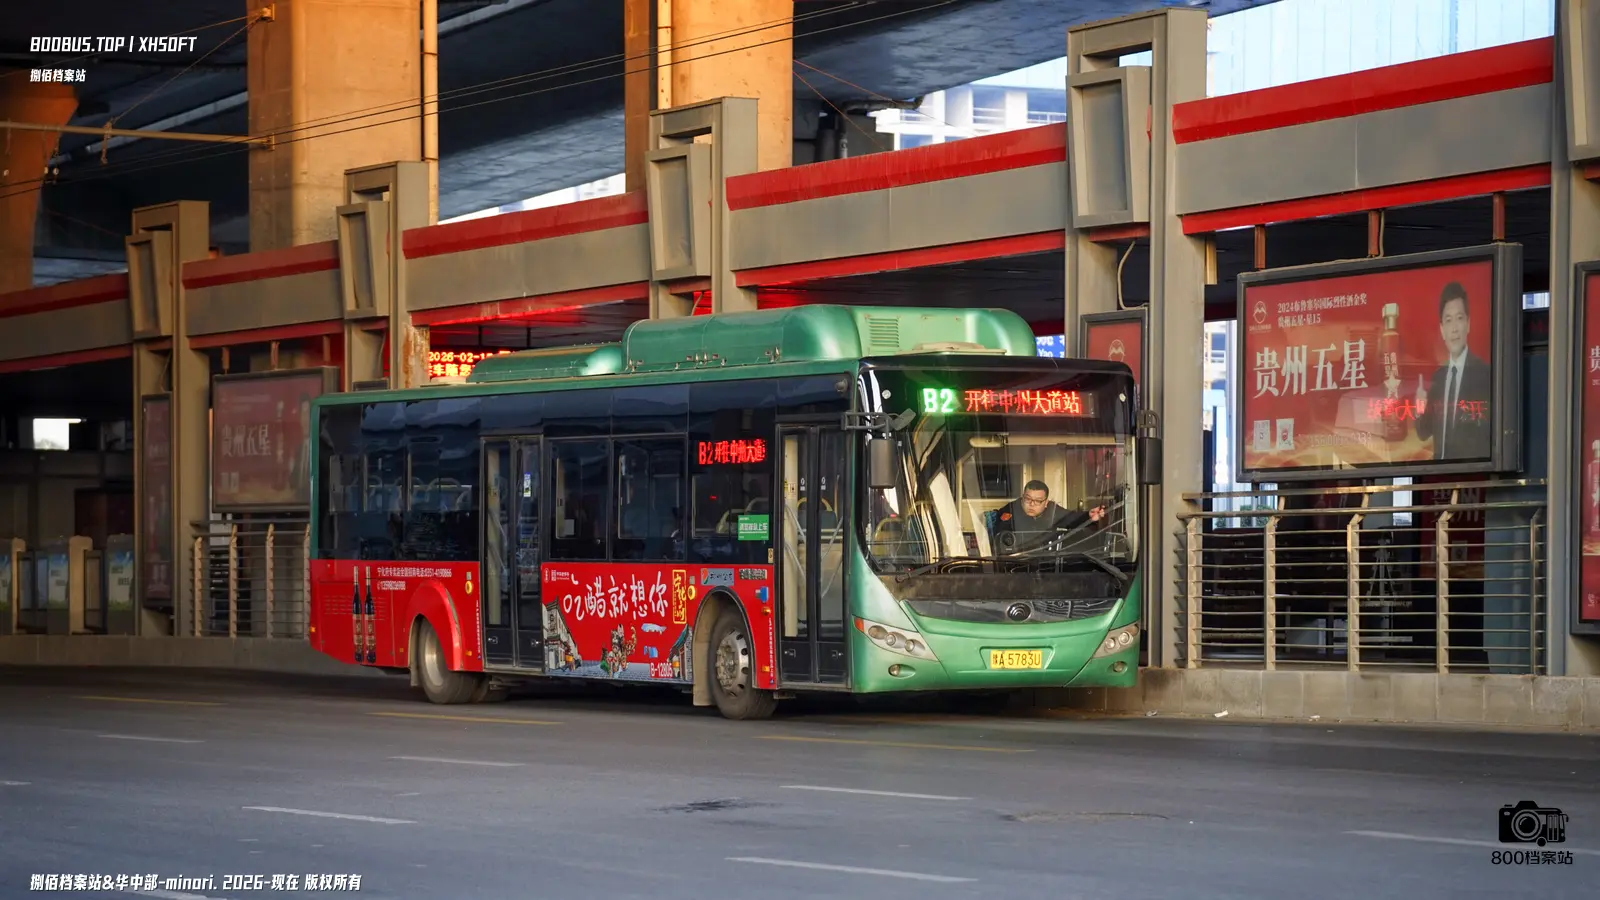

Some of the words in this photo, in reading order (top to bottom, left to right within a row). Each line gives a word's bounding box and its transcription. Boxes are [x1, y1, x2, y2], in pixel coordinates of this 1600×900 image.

[428, 351, 493, 363] 2026-02-1
[1253, 338, 1368, 399] 贵州五星
[923, 388, 954, 412] B2
[964, 390, 1081, 414] 开往中州大道站
[698, 441, 713, 465] B2
[563, 571, 669, 621] 吃醋就想你
